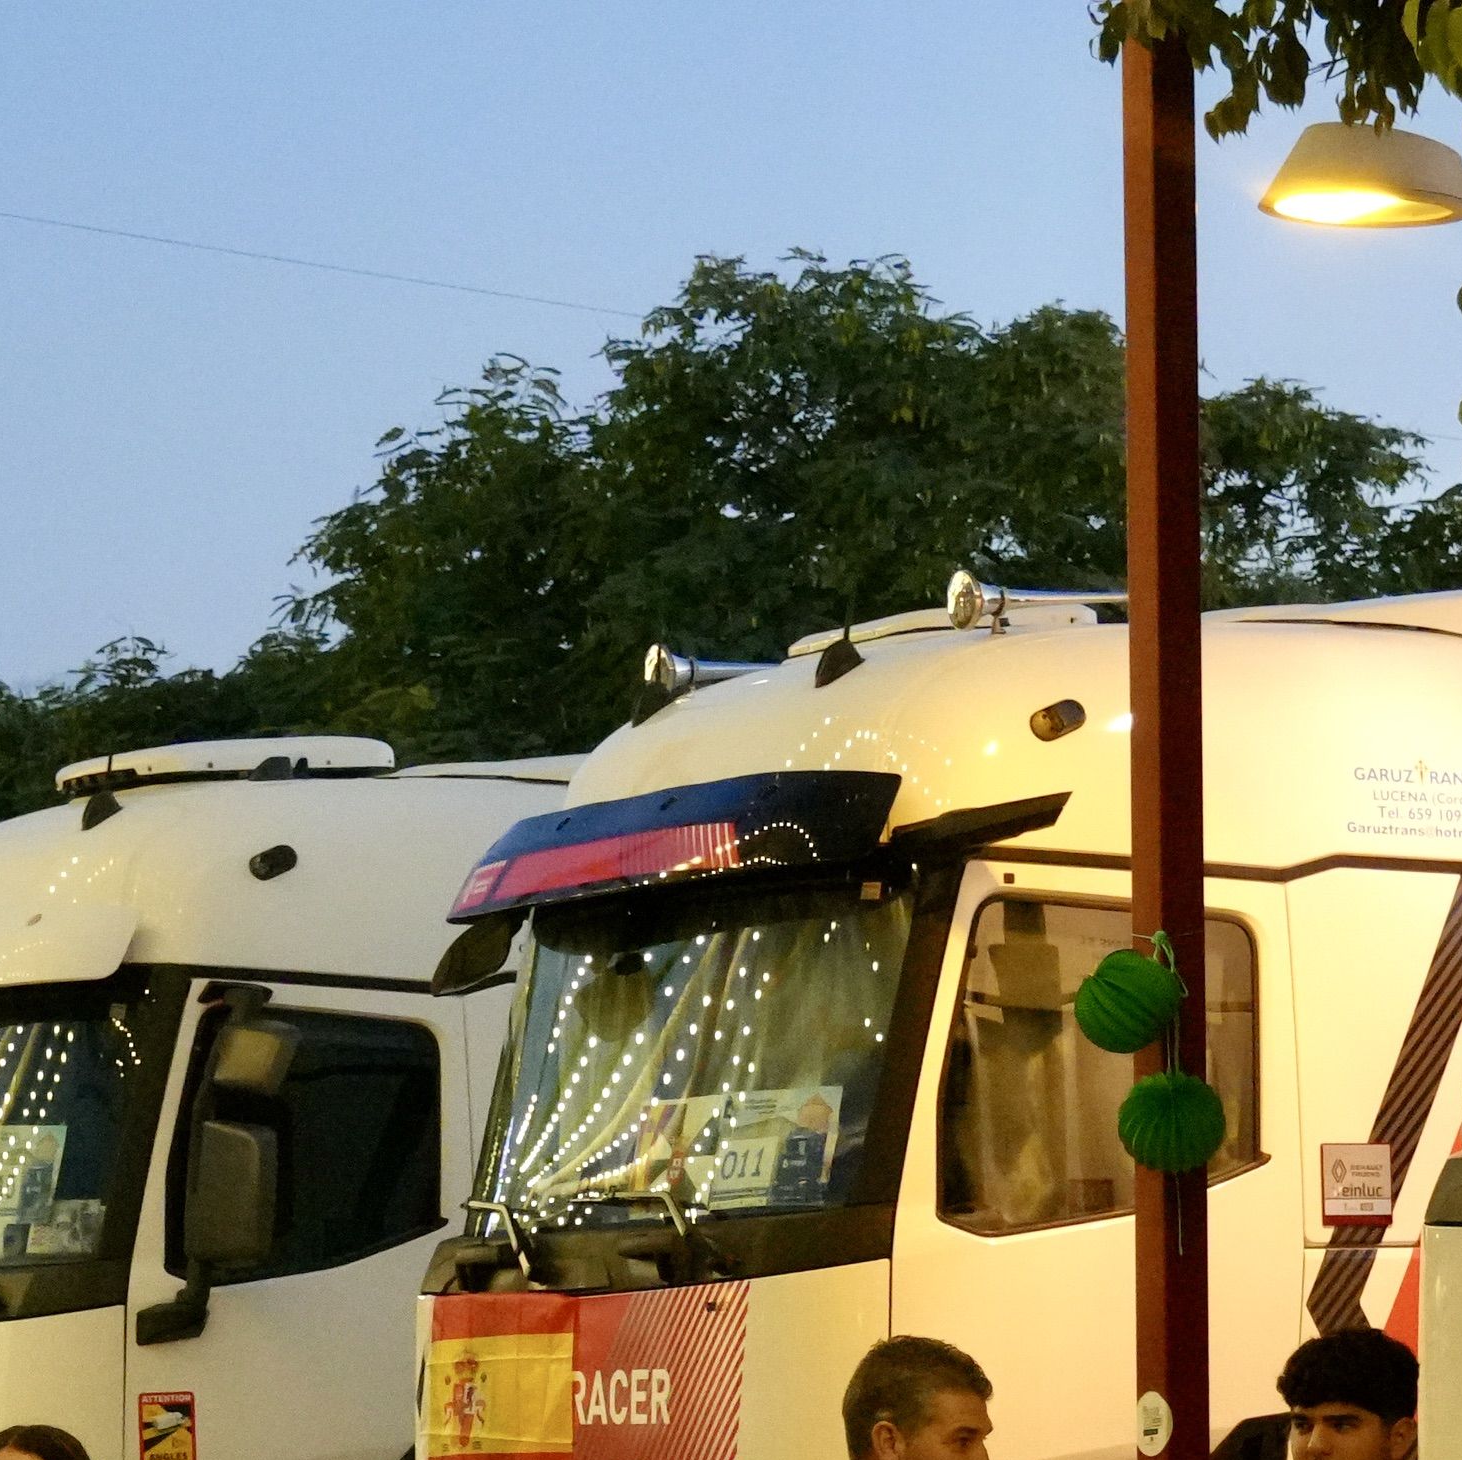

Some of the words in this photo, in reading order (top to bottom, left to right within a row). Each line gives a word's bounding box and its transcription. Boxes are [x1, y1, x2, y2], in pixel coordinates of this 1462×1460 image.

[1373, 789, 1428, 803] LUCENA
[1408, 808, 1432, 820] 659
[1439, 809, 1461, 823] 109
[720, 1148, 765, 1180] 011
[1332, 1182, 1383, 1197] einluc
[571, 1368, 671, 1425] RACER
